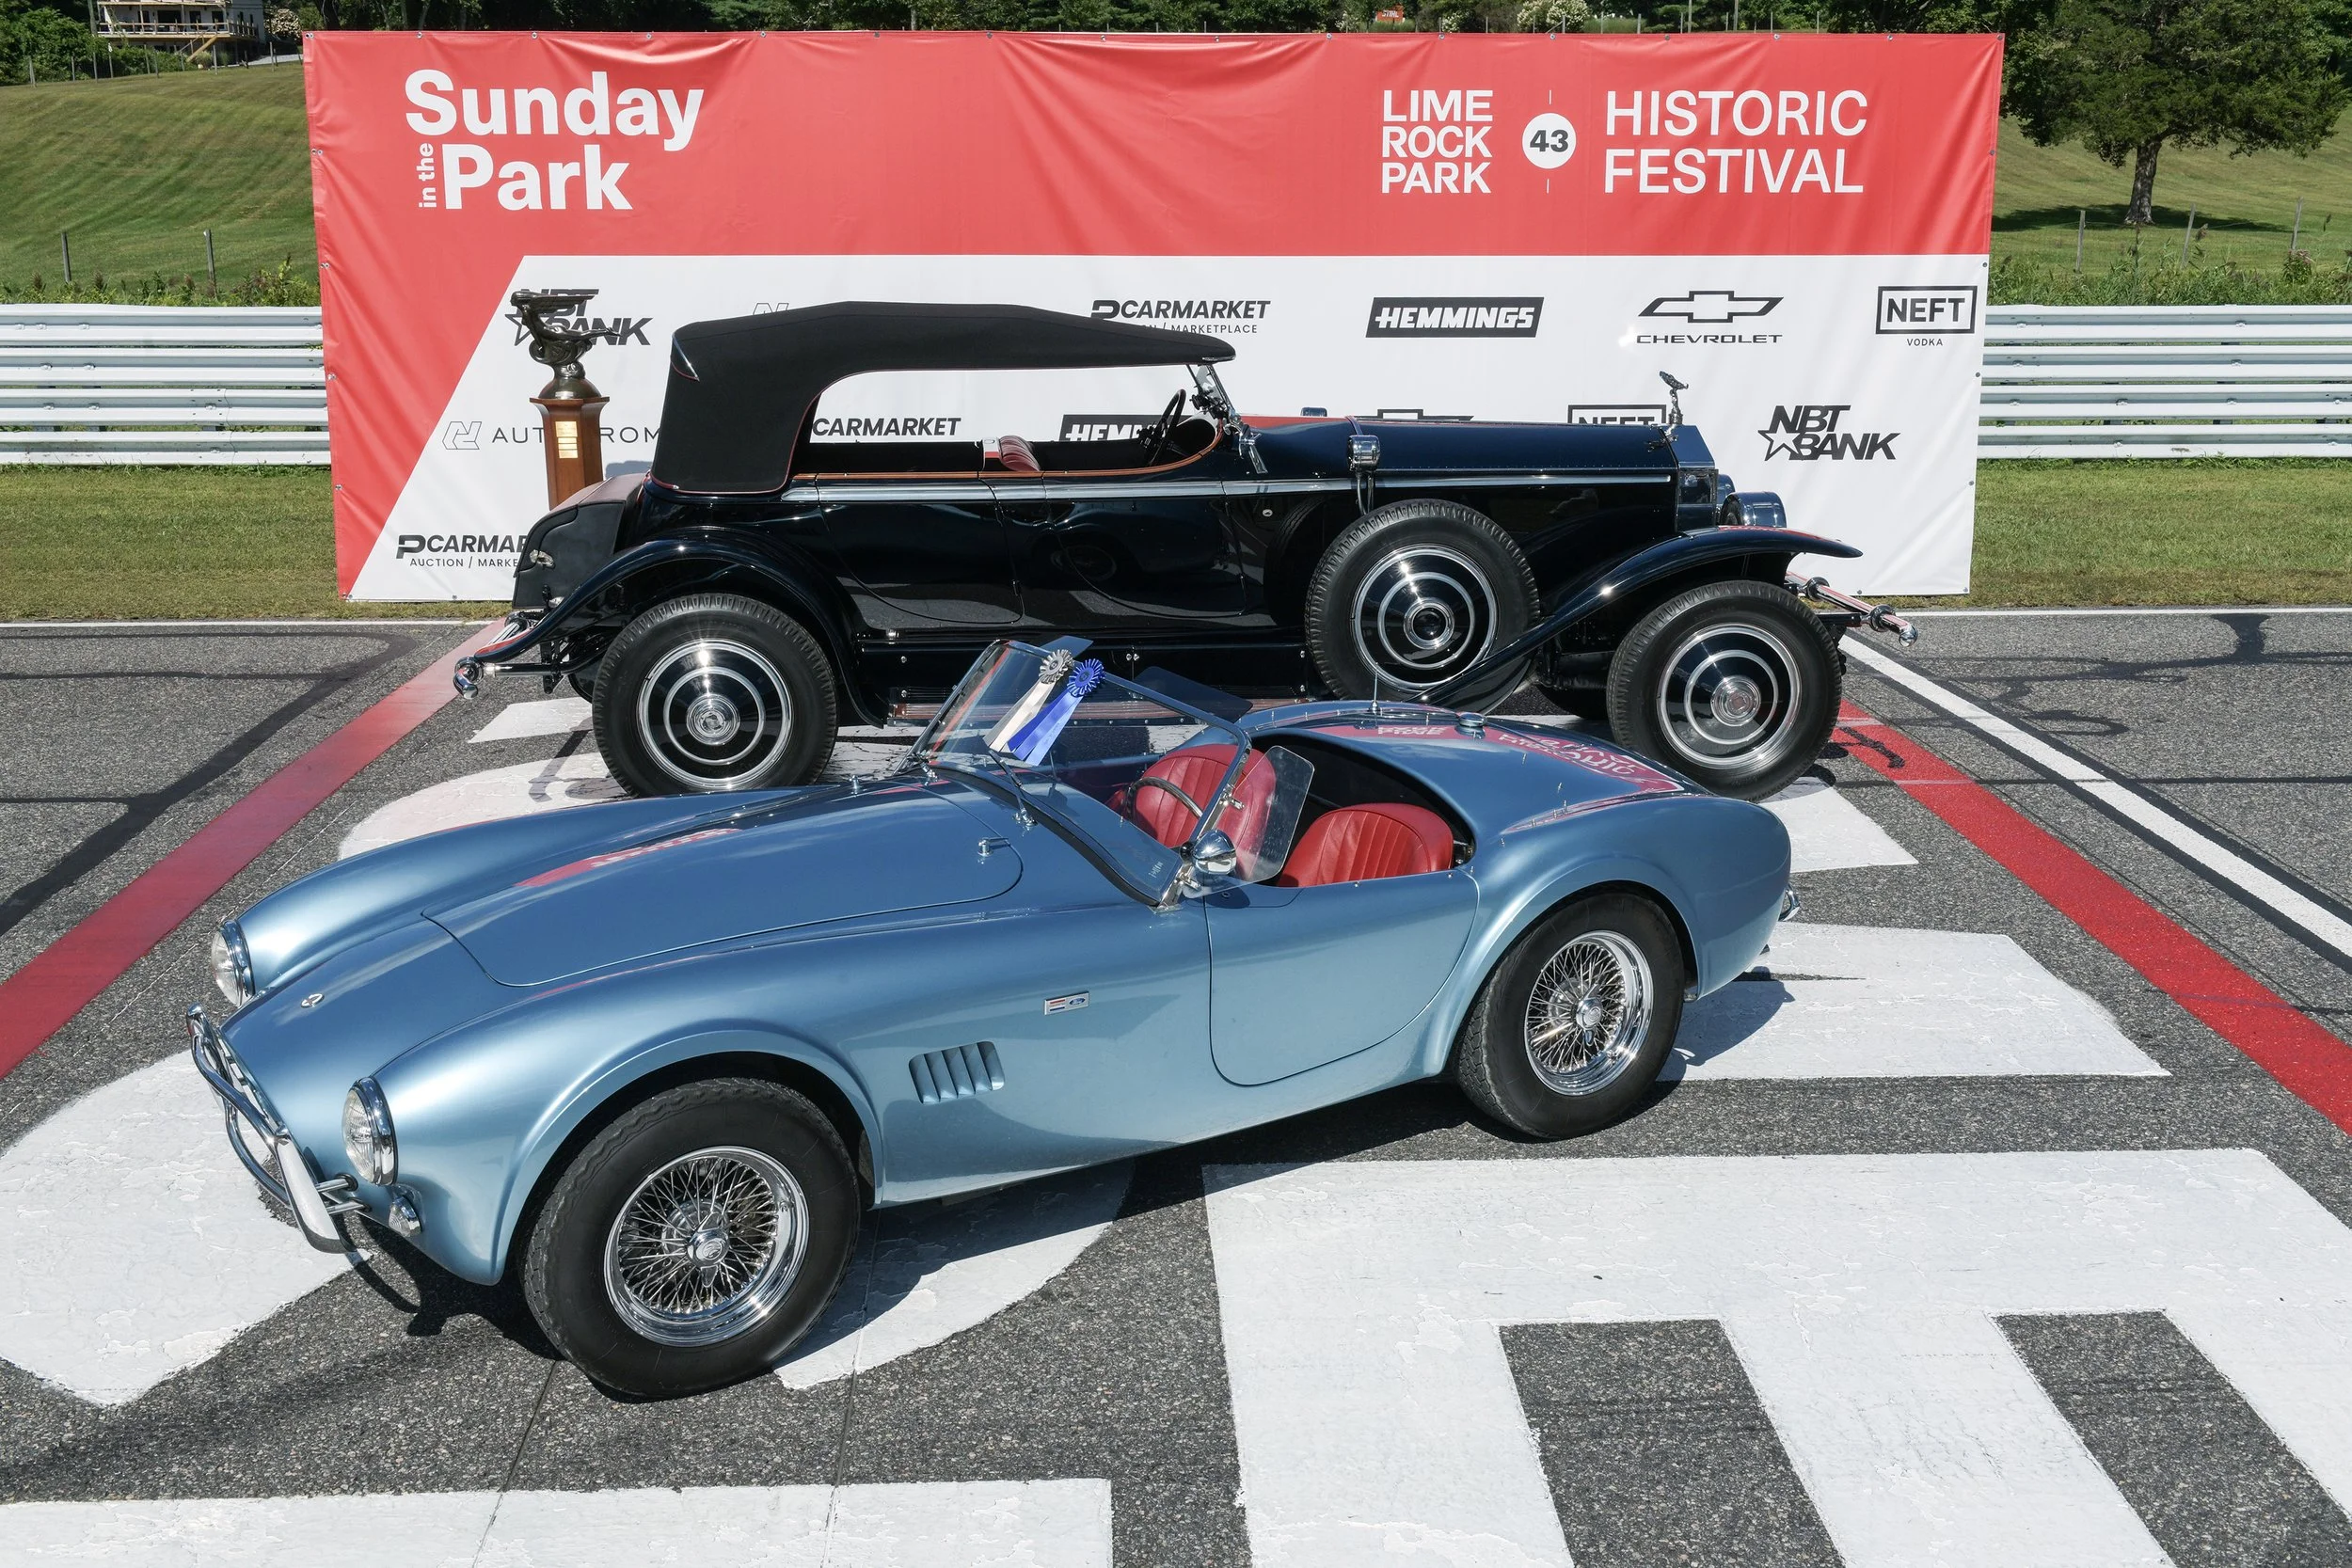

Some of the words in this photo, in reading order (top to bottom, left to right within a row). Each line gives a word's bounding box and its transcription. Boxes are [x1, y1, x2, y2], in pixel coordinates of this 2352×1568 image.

[405, 69, 705, 151] Sunday
[1383, 89, 1494, 122] LIME
[1606, 89, 1868, 136] HISTORIC
[1381, 125, 1493, 159] ROCK
[1529, 129, 1569, 152] 43
[416, 143, 435, 182] the
[1604, 148, 1865, 194] FESTIVAL
[441, 143, 634, 211] Park
[1381, 162, 1492, 194] PARK
[418, 187, 437, 209] in
[1375, 307, 1535, 328] HEMMINGS
[1886, 297, 1966, 323] NEFT
[1636, 334, 1783, 344] CHEVROLET
[1906, 338, 1944, 347] VODKA
[812, 417, 961, 436] CARMARKET
[1768, 404, 1851, 433] NBT
[1788, 433, 1901, 461] BANK
[409, 558, 464, 567] AUCTION
